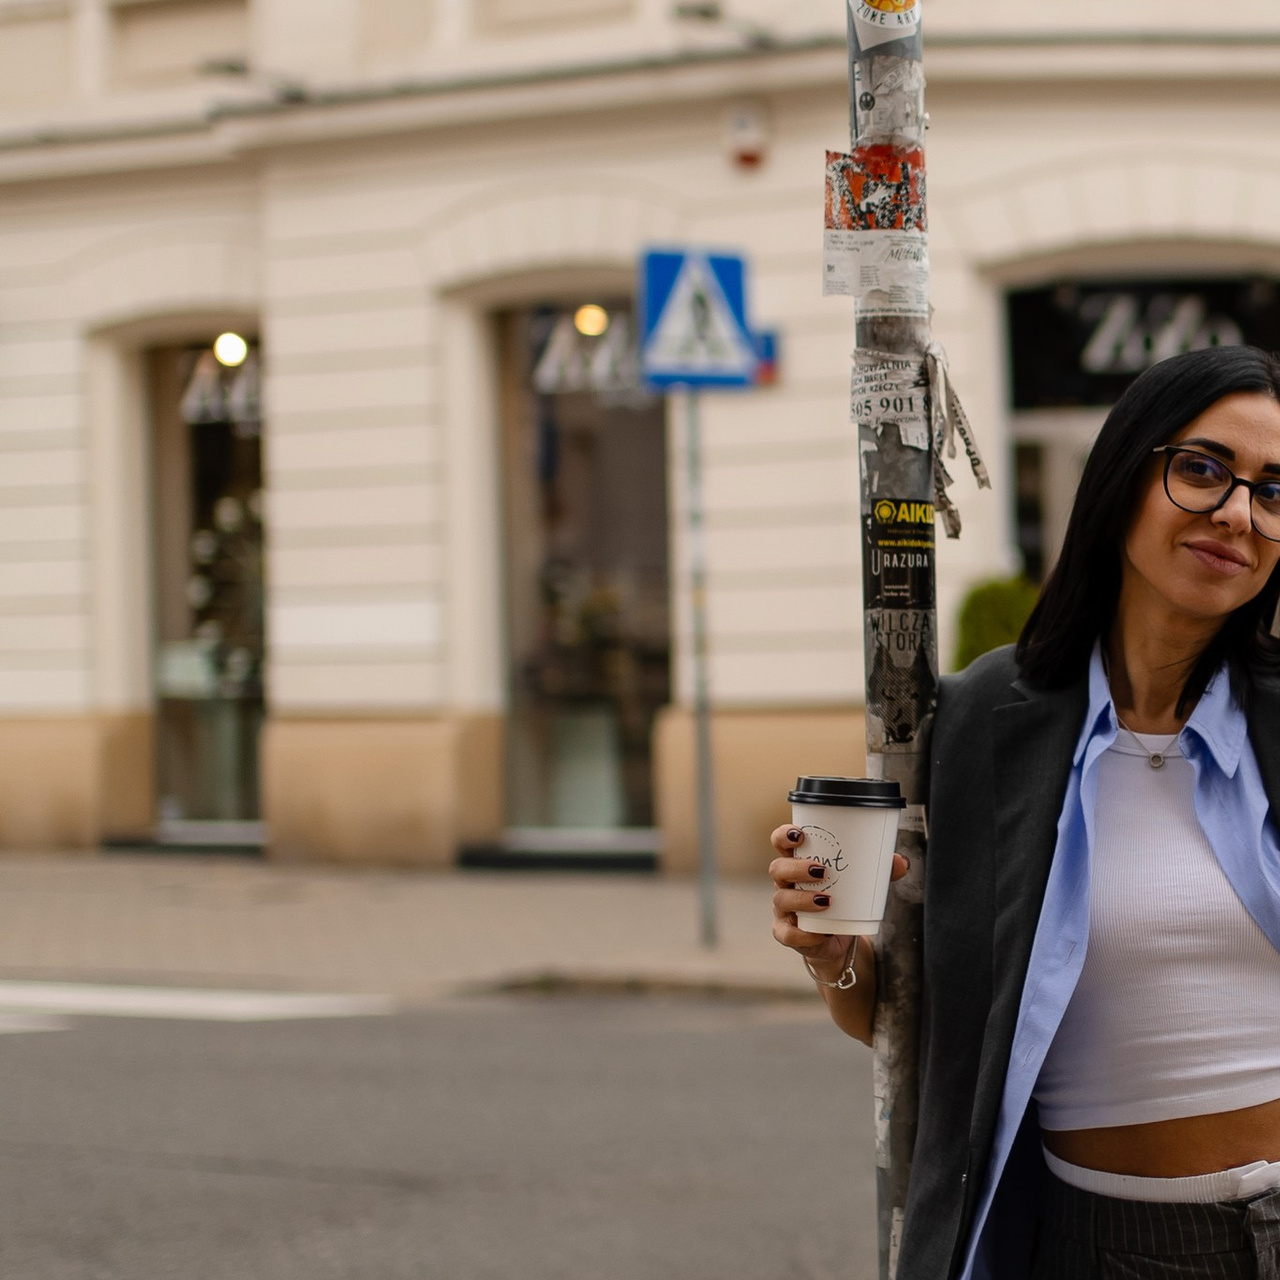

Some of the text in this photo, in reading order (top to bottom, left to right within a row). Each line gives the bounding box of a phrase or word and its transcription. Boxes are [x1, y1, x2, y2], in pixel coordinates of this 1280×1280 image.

[880, 396, 914, 413] 901
[870, 611, 930, 632] WILCZA
[875, 631, 927, 652] STORE
